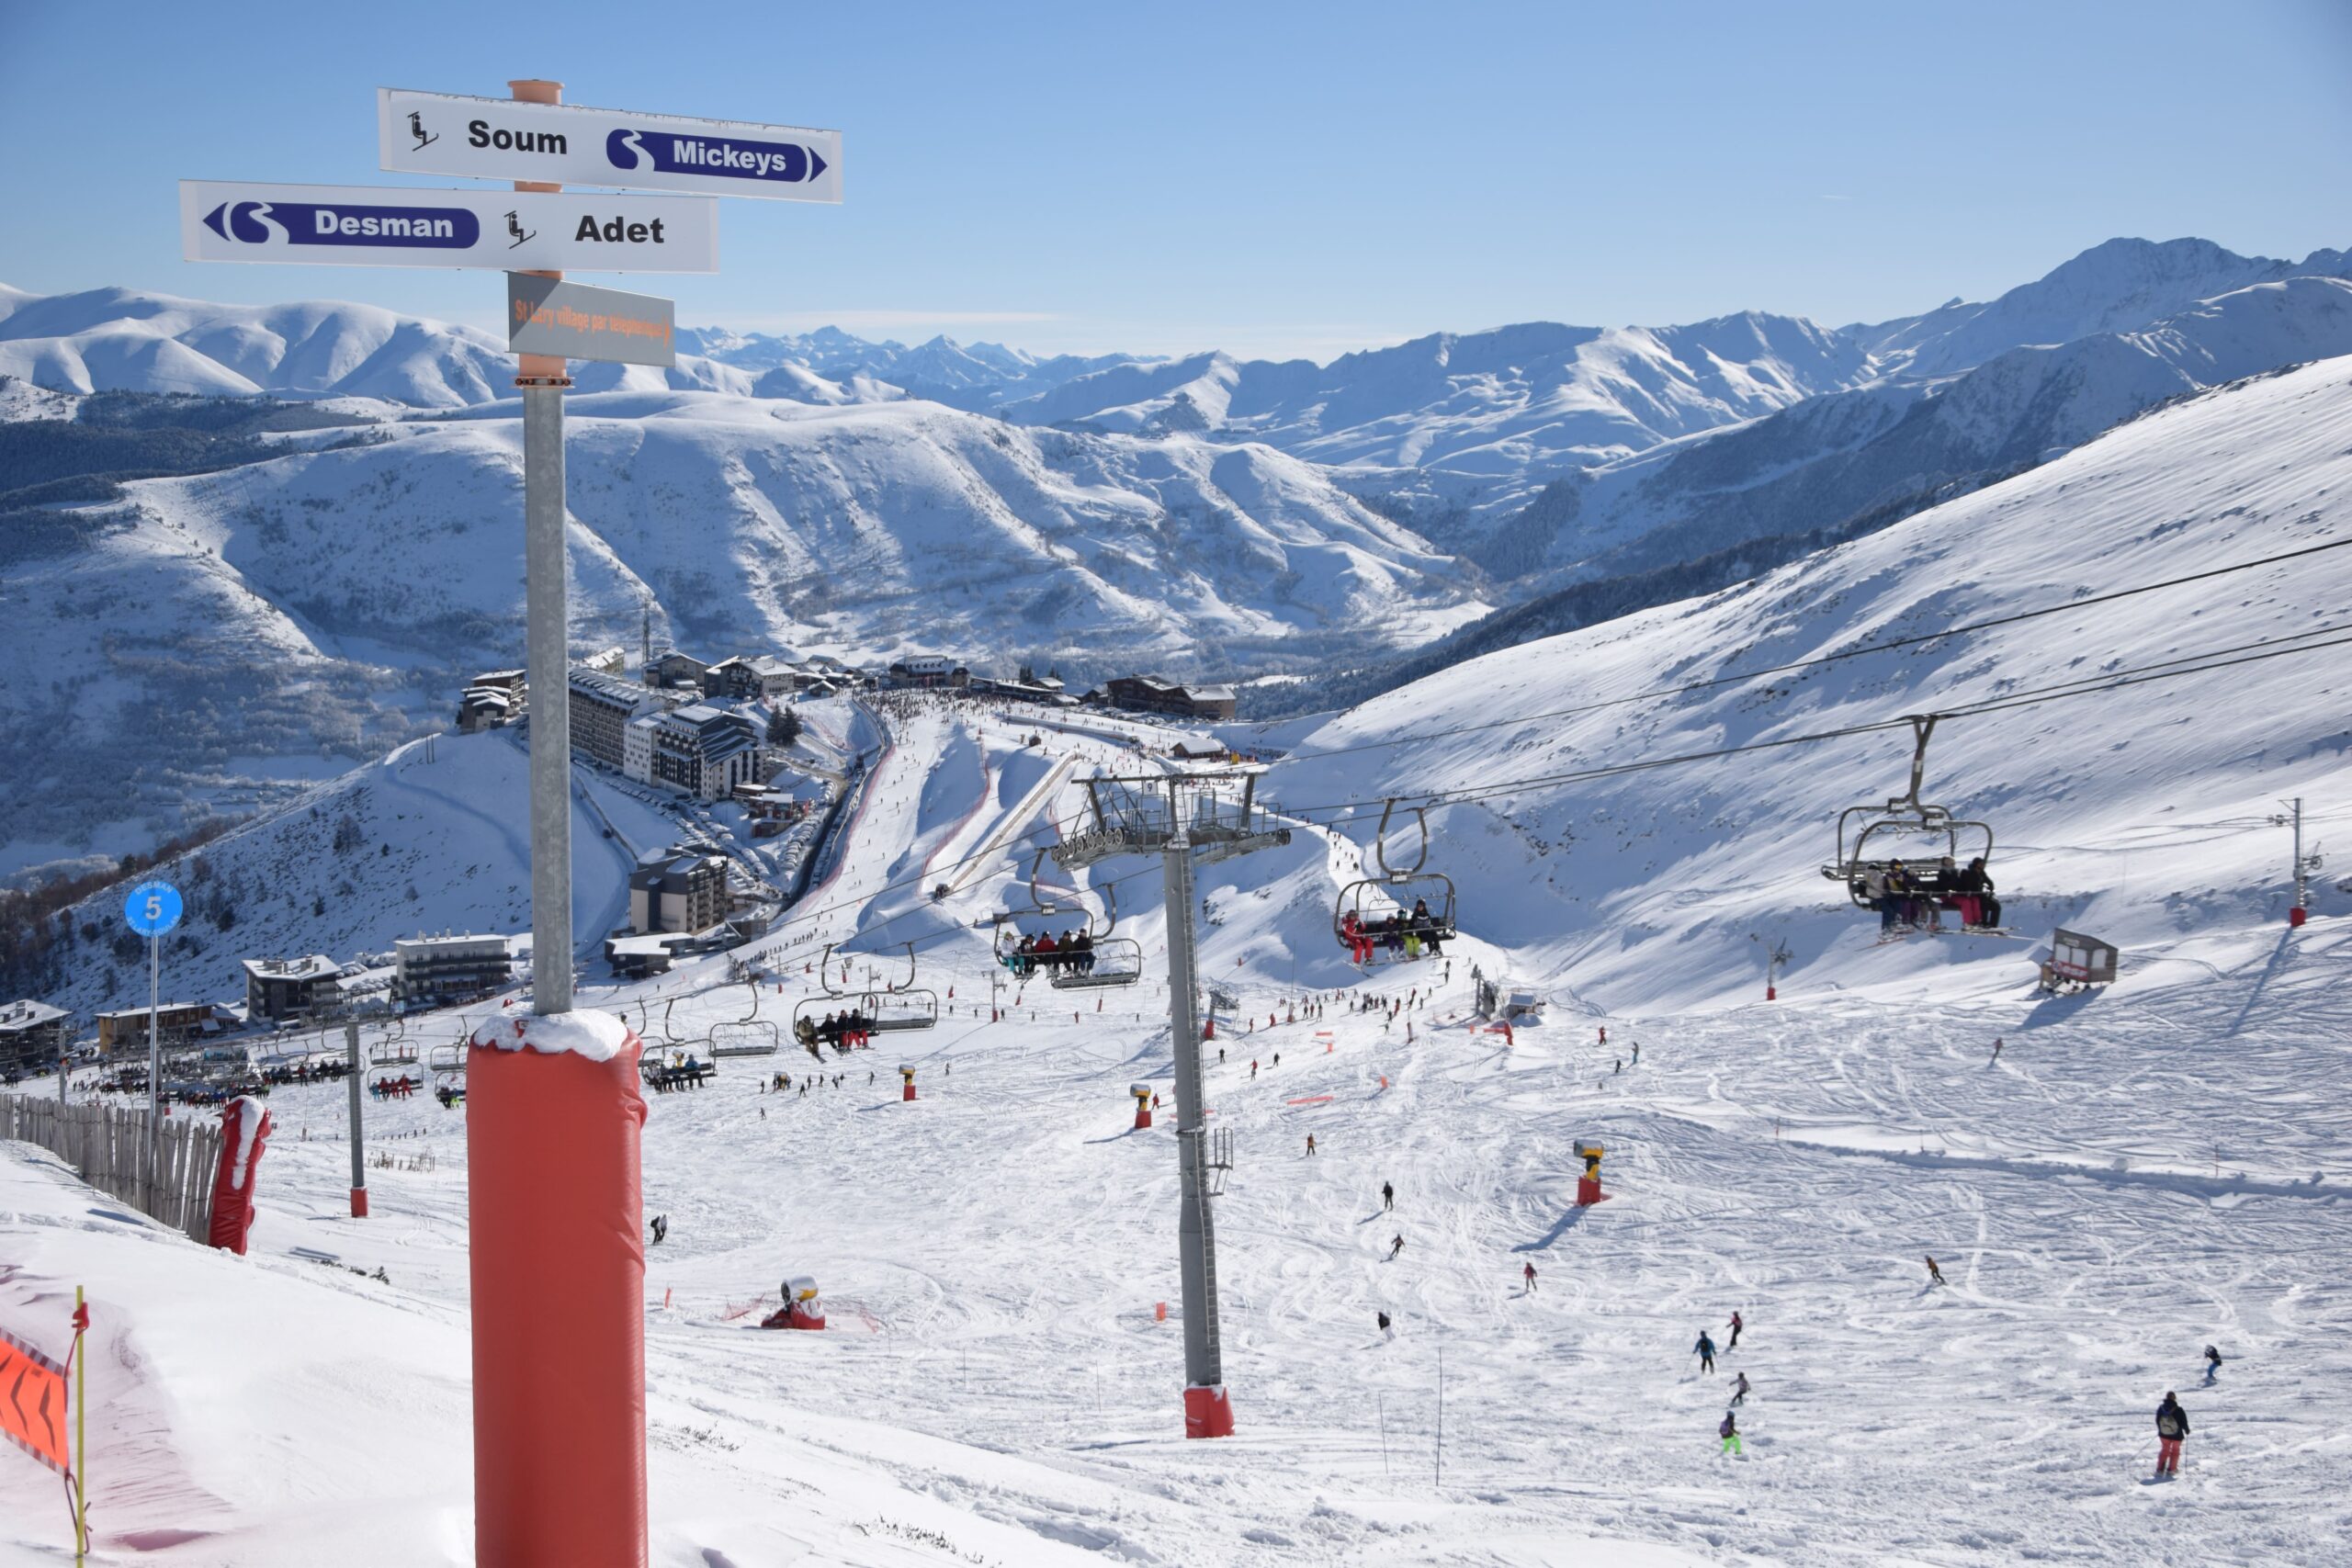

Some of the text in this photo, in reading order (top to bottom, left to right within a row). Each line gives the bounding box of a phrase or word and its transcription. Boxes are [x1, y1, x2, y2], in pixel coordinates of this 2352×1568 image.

[468, 119, 786, 175] Soum Mickeys
[315, 209, 664, 243] Desman Adet
[514, 299, 527, 322] St
[529, 301, 553, 330] Lary
[557, 304, 589, 332] village
[591, 315, 606, 336] par
[1148, 783, 1153, 792] 9
[134, 880, 174, 895] DESMAN
[146, 896, 162, 919] 5
